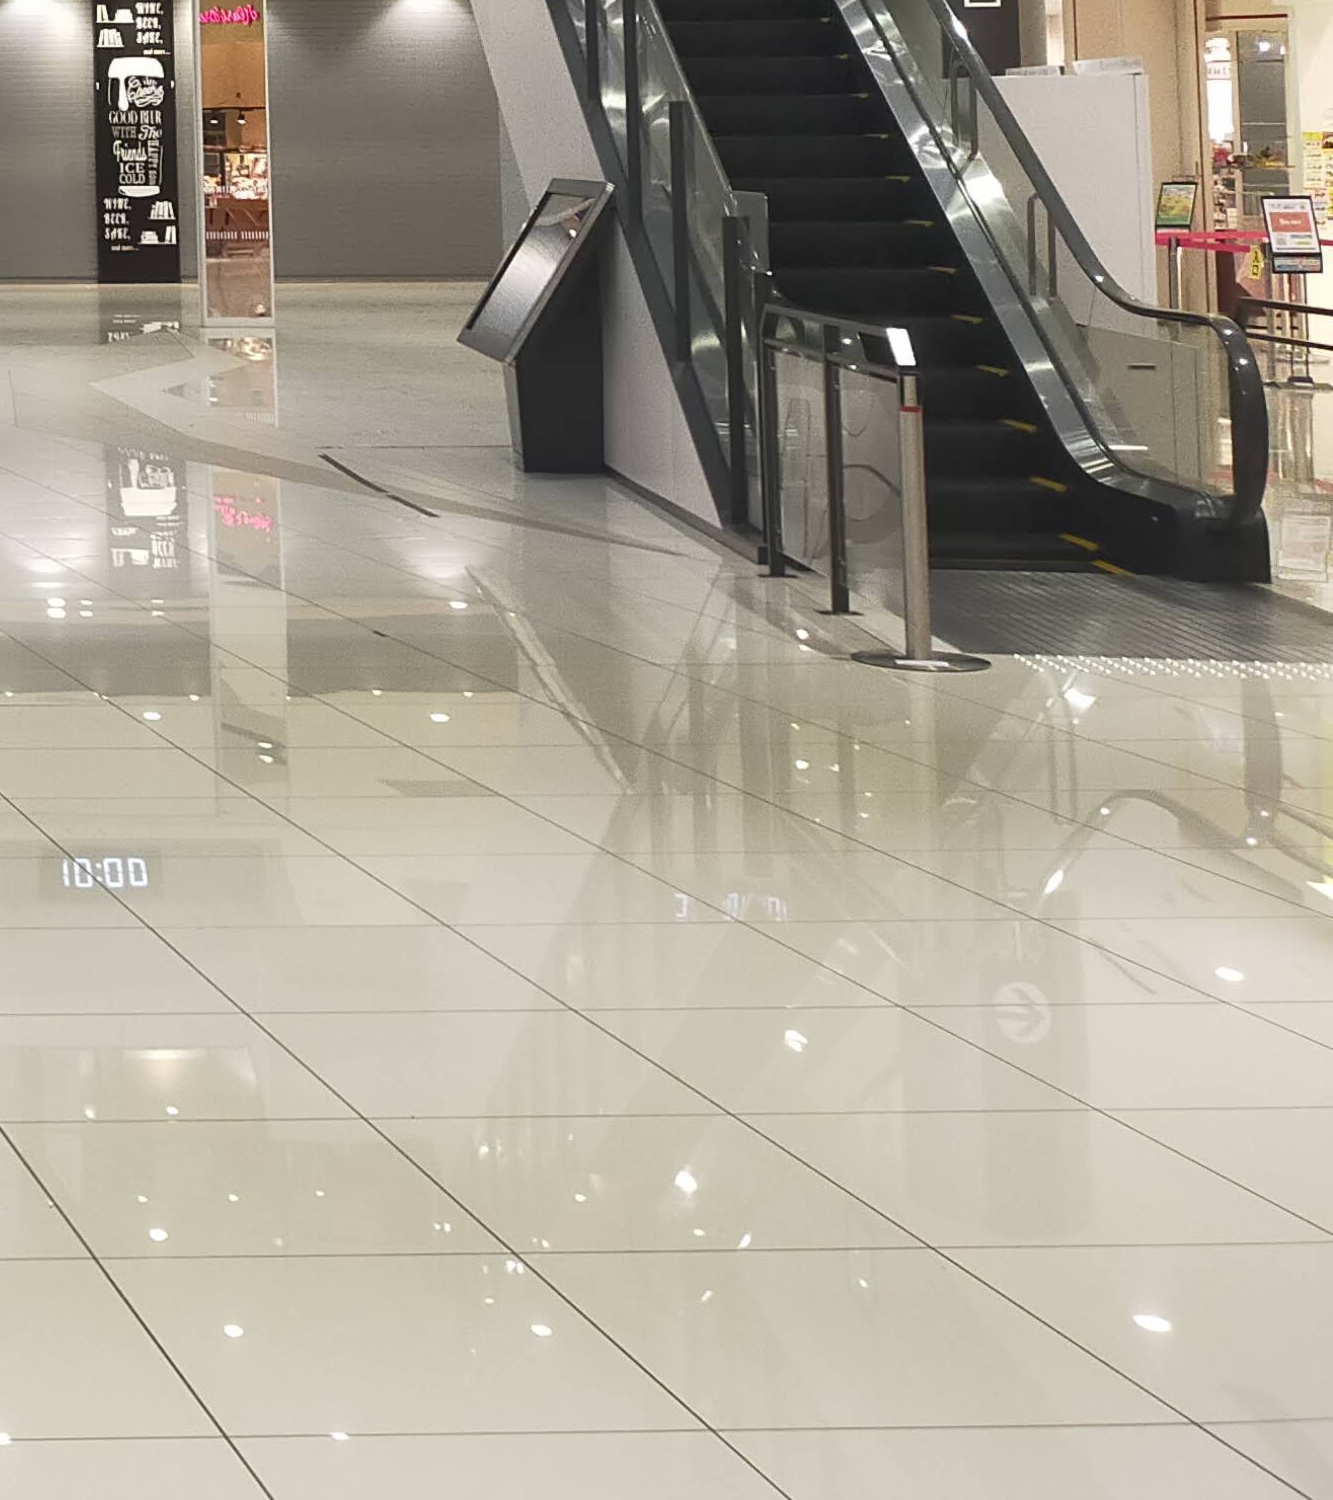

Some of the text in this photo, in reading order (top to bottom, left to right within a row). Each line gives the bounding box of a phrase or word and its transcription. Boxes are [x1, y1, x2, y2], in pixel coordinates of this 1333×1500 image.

[108, 110, 139, 125] GOOD
[119, 162, 145, 174] ICE
[118, 173, 146, 185] COLD
